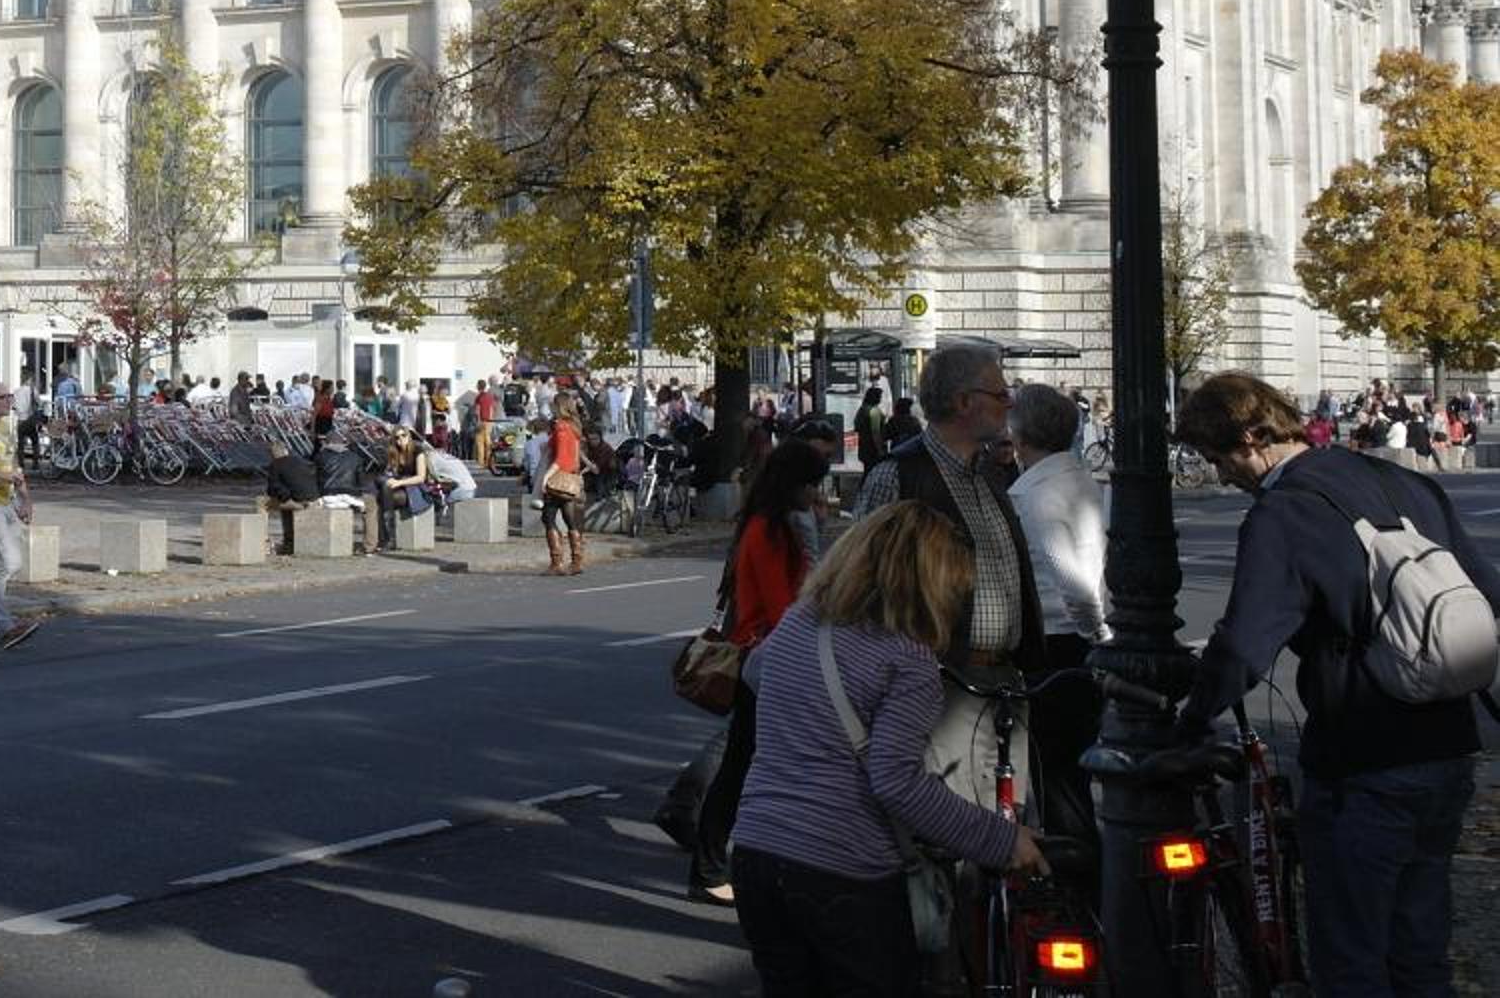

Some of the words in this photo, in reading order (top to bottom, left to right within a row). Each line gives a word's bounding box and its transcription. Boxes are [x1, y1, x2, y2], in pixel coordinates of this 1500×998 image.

[911, 299, 922, 312] H
[1251, 809, 1268, 851] BIKE
[1252, 854, 1269, 866] A
[1253, 873, 1275, 922] RENT
